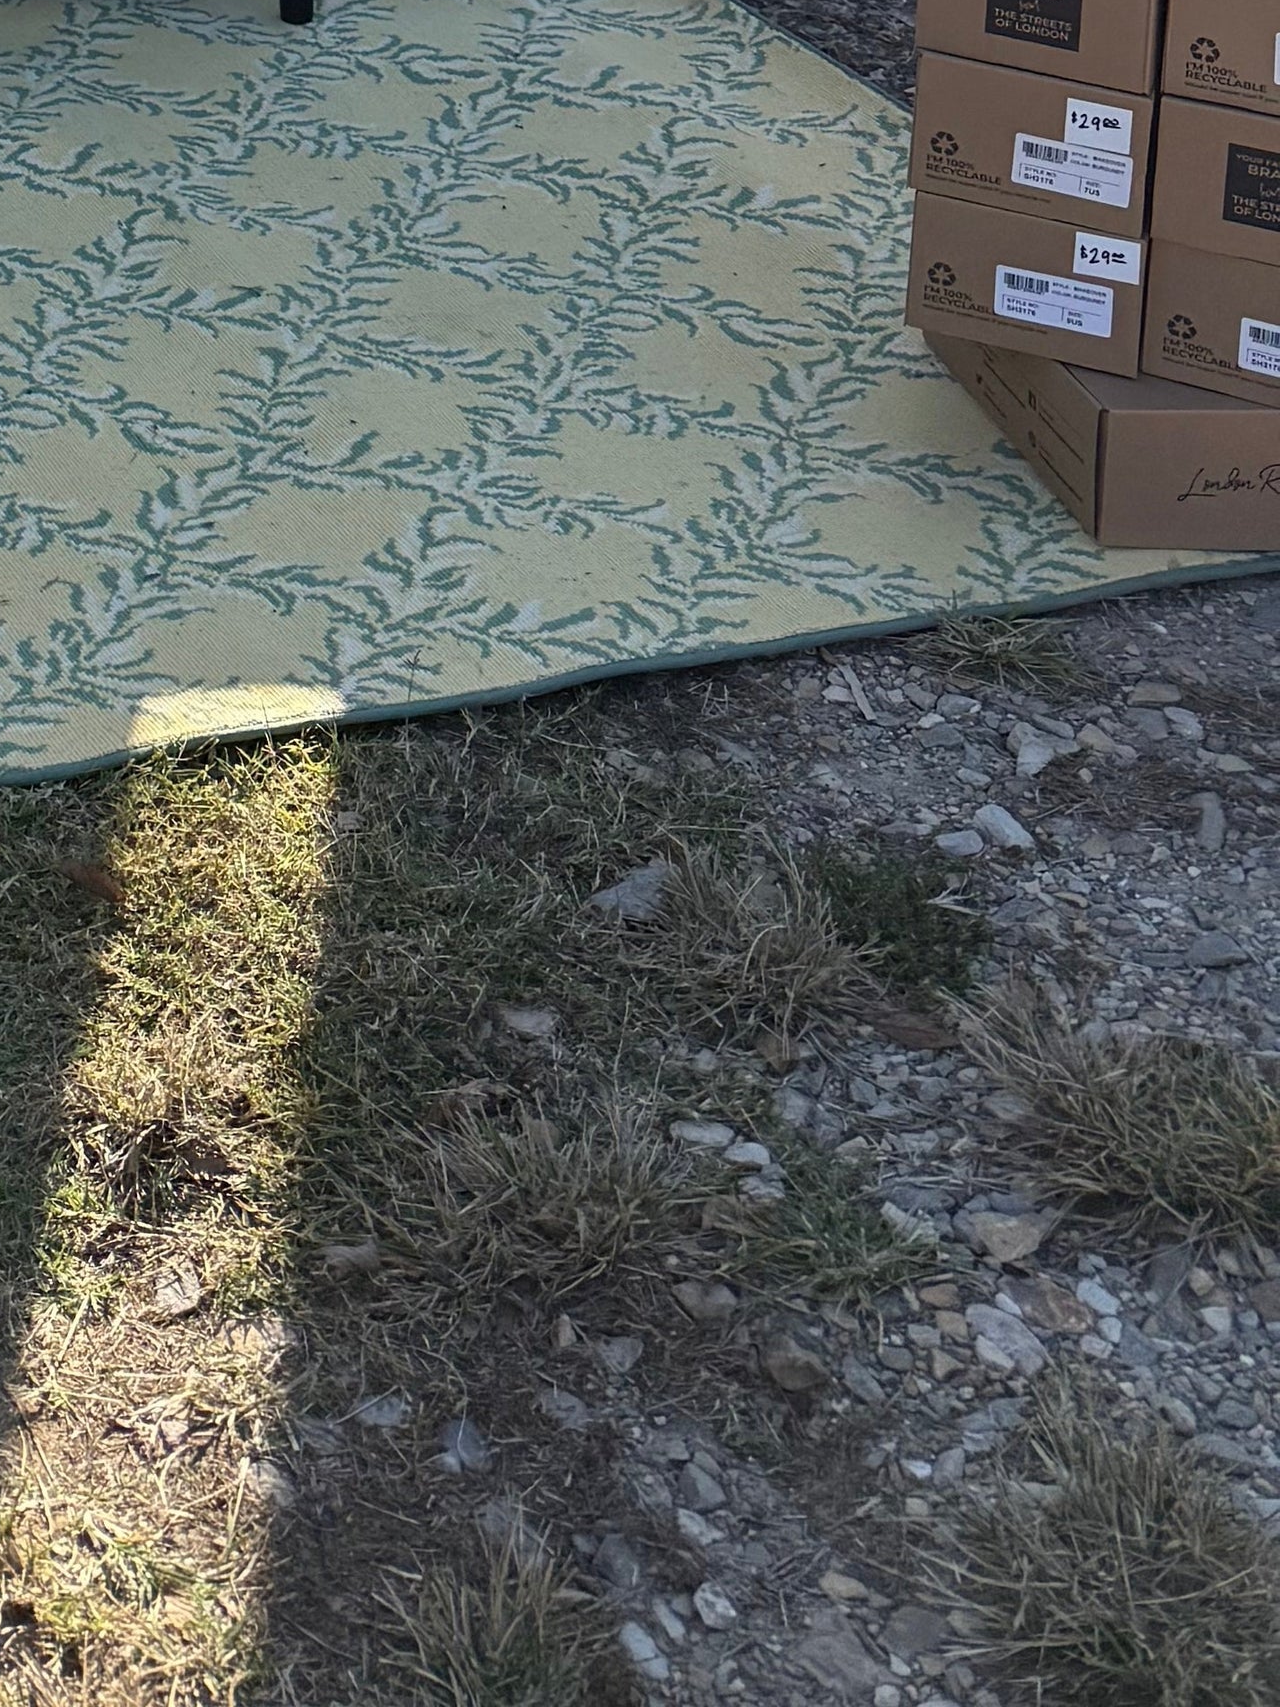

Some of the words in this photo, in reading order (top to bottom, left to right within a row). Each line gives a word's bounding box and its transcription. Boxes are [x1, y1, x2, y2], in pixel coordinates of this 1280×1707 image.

[994, 7, 1018, 19] THE
[995, 18, 1013, 28] OF
[1015, 22, 1070, 41] LONDON
[1185, 70, 1268, 93] RECYCLABLE
[1206, 65, 1239, 78] 100%
[926, 163, 1002, 185] RECYCLABLE
[924, 293, 993, 315] RECYCLABL
[1163, 345, 1235, 370] RECYCLABL
